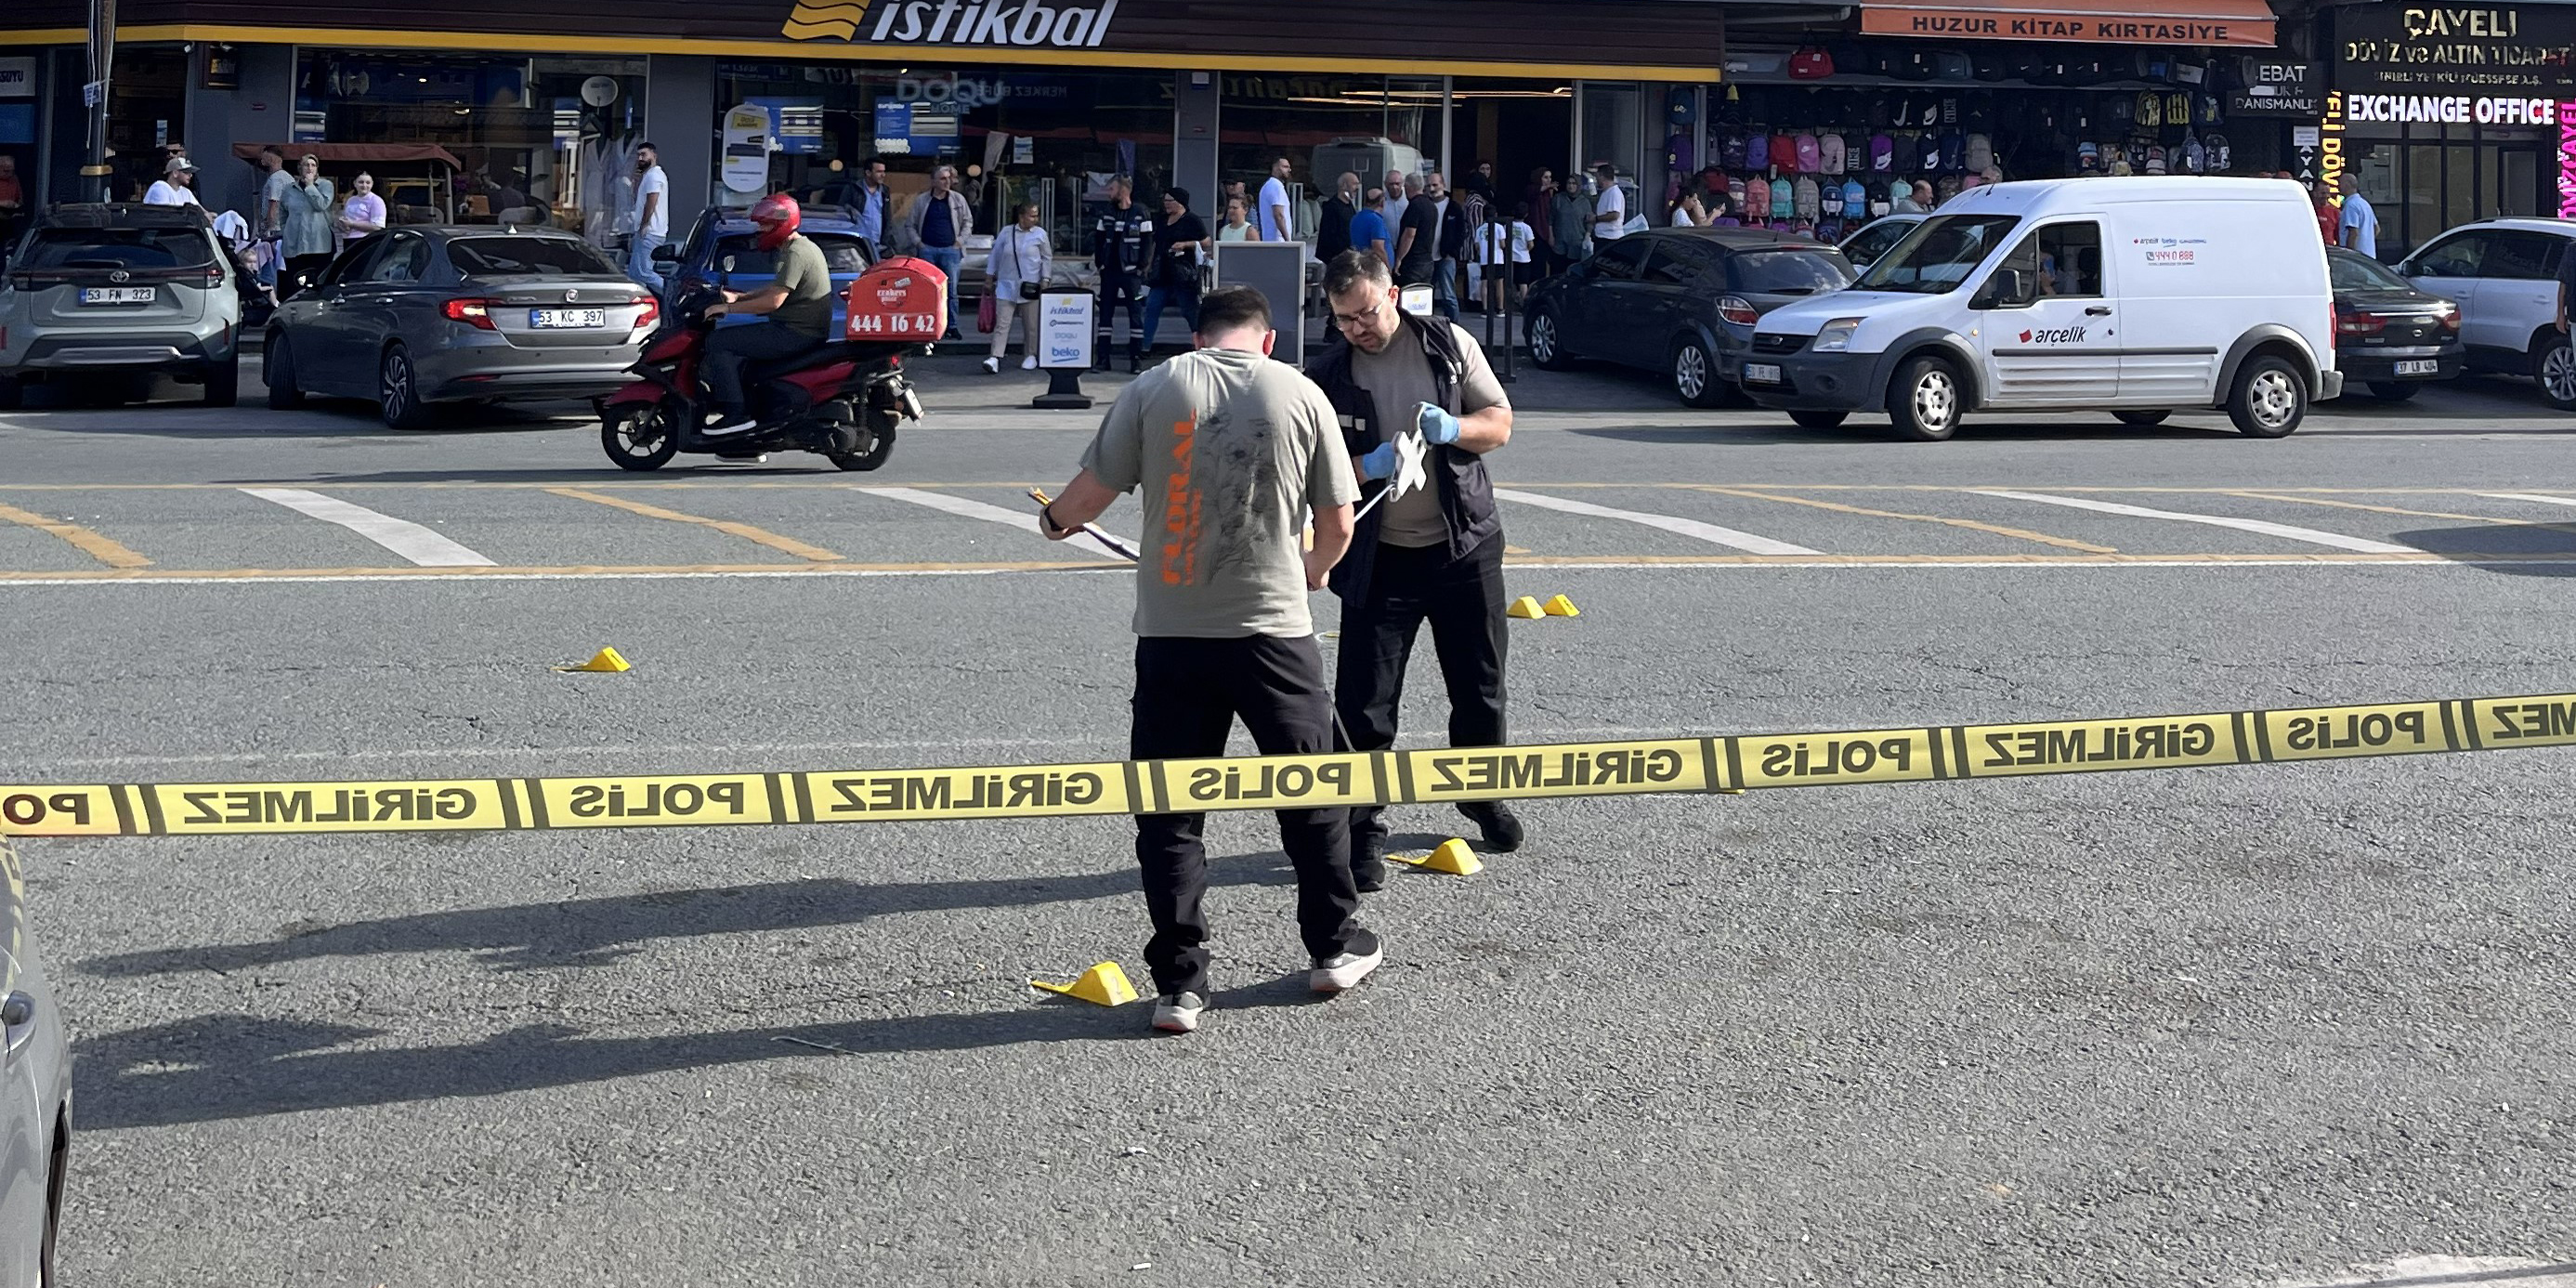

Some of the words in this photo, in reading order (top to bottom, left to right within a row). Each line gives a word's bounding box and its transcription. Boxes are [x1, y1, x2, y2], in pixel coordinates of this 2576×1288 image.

[870, 0, 1118, 46] istikbal
[1913, 16, 1998, 34] HUZUR
[2011, 17, 2084, 36] KİTAP
[2098, 20, 2229, 40] KIRTASİYE
[2345, 36, 2401, 63] DÖVİZ
[2432, 44, 2487, 65] ALTIN
[2256, 65, 2308, 83] EBAT
[2347, 94, 2471, 123] EXCHANGE
[2475, 96, 2555, 125] OFFICE
[87, 290, 101, 300] 53
[132, 289, 151, 300] 323
[539, 311, 553, 322] 53
[561, 311, 575, 322] KC
[582, 310, 603, 322] 397
[851, 314, 883, 333] 444
[891, 314, 909, 333] 16
[915, 314, 935, 333] 42
[2034, 326, 2087, 347] arçelik
[1052, 347, 1080, 357] beko
